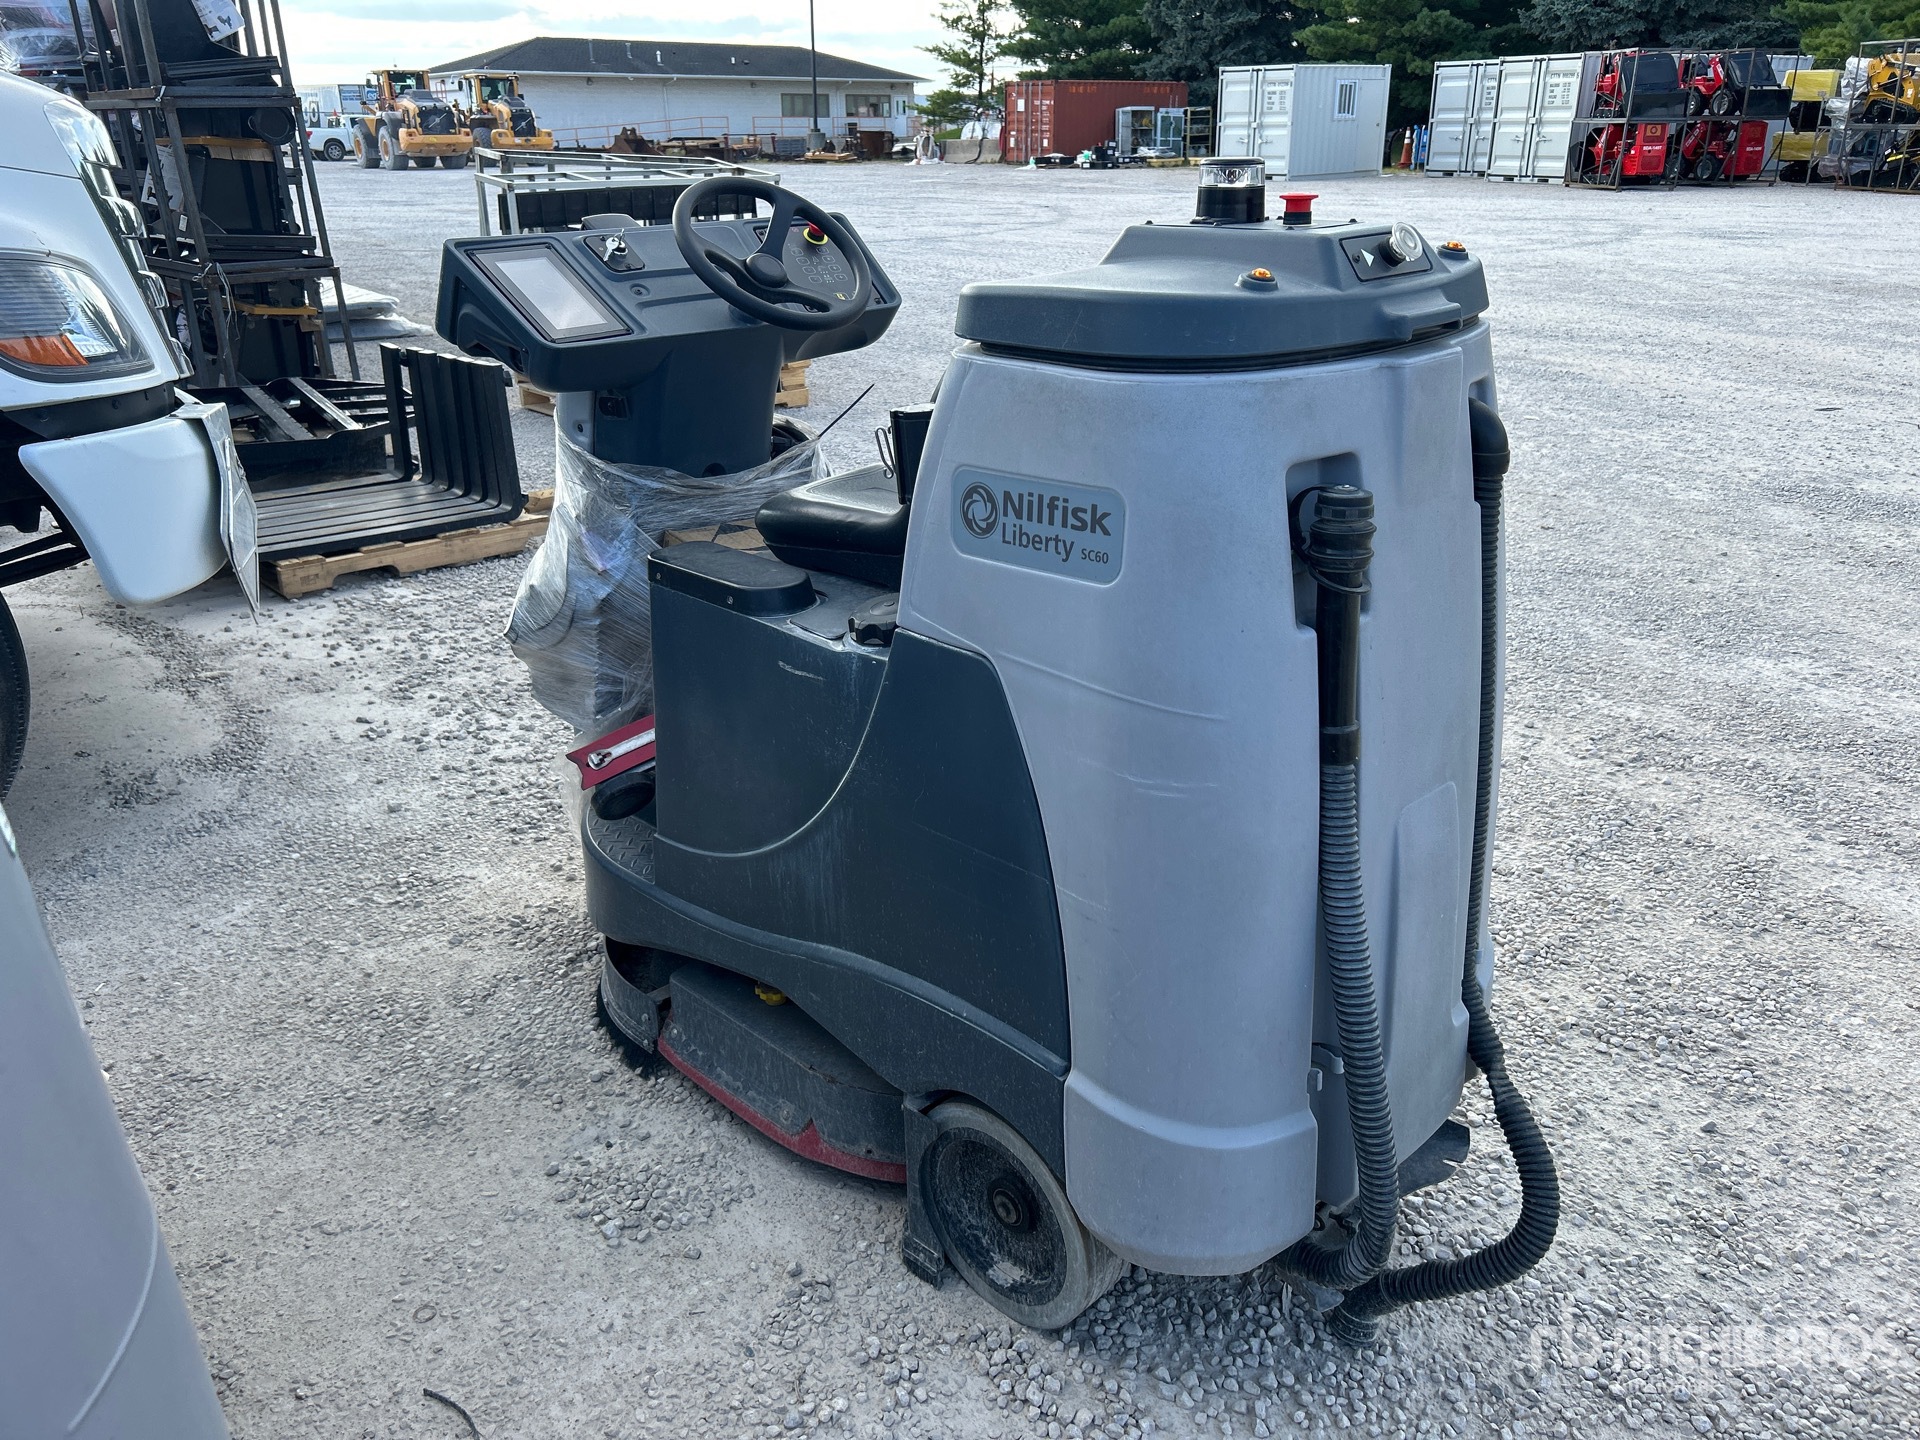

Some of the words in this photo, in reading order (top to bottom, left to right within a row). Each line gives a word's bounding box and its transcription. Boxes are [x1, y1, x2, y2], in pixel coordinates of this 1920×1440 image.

[1002, 490, 1112, 537] Nilfisk
[1002, 522, 1075, 563] Liberty
[1081, 548, 1109, 564] SC60
